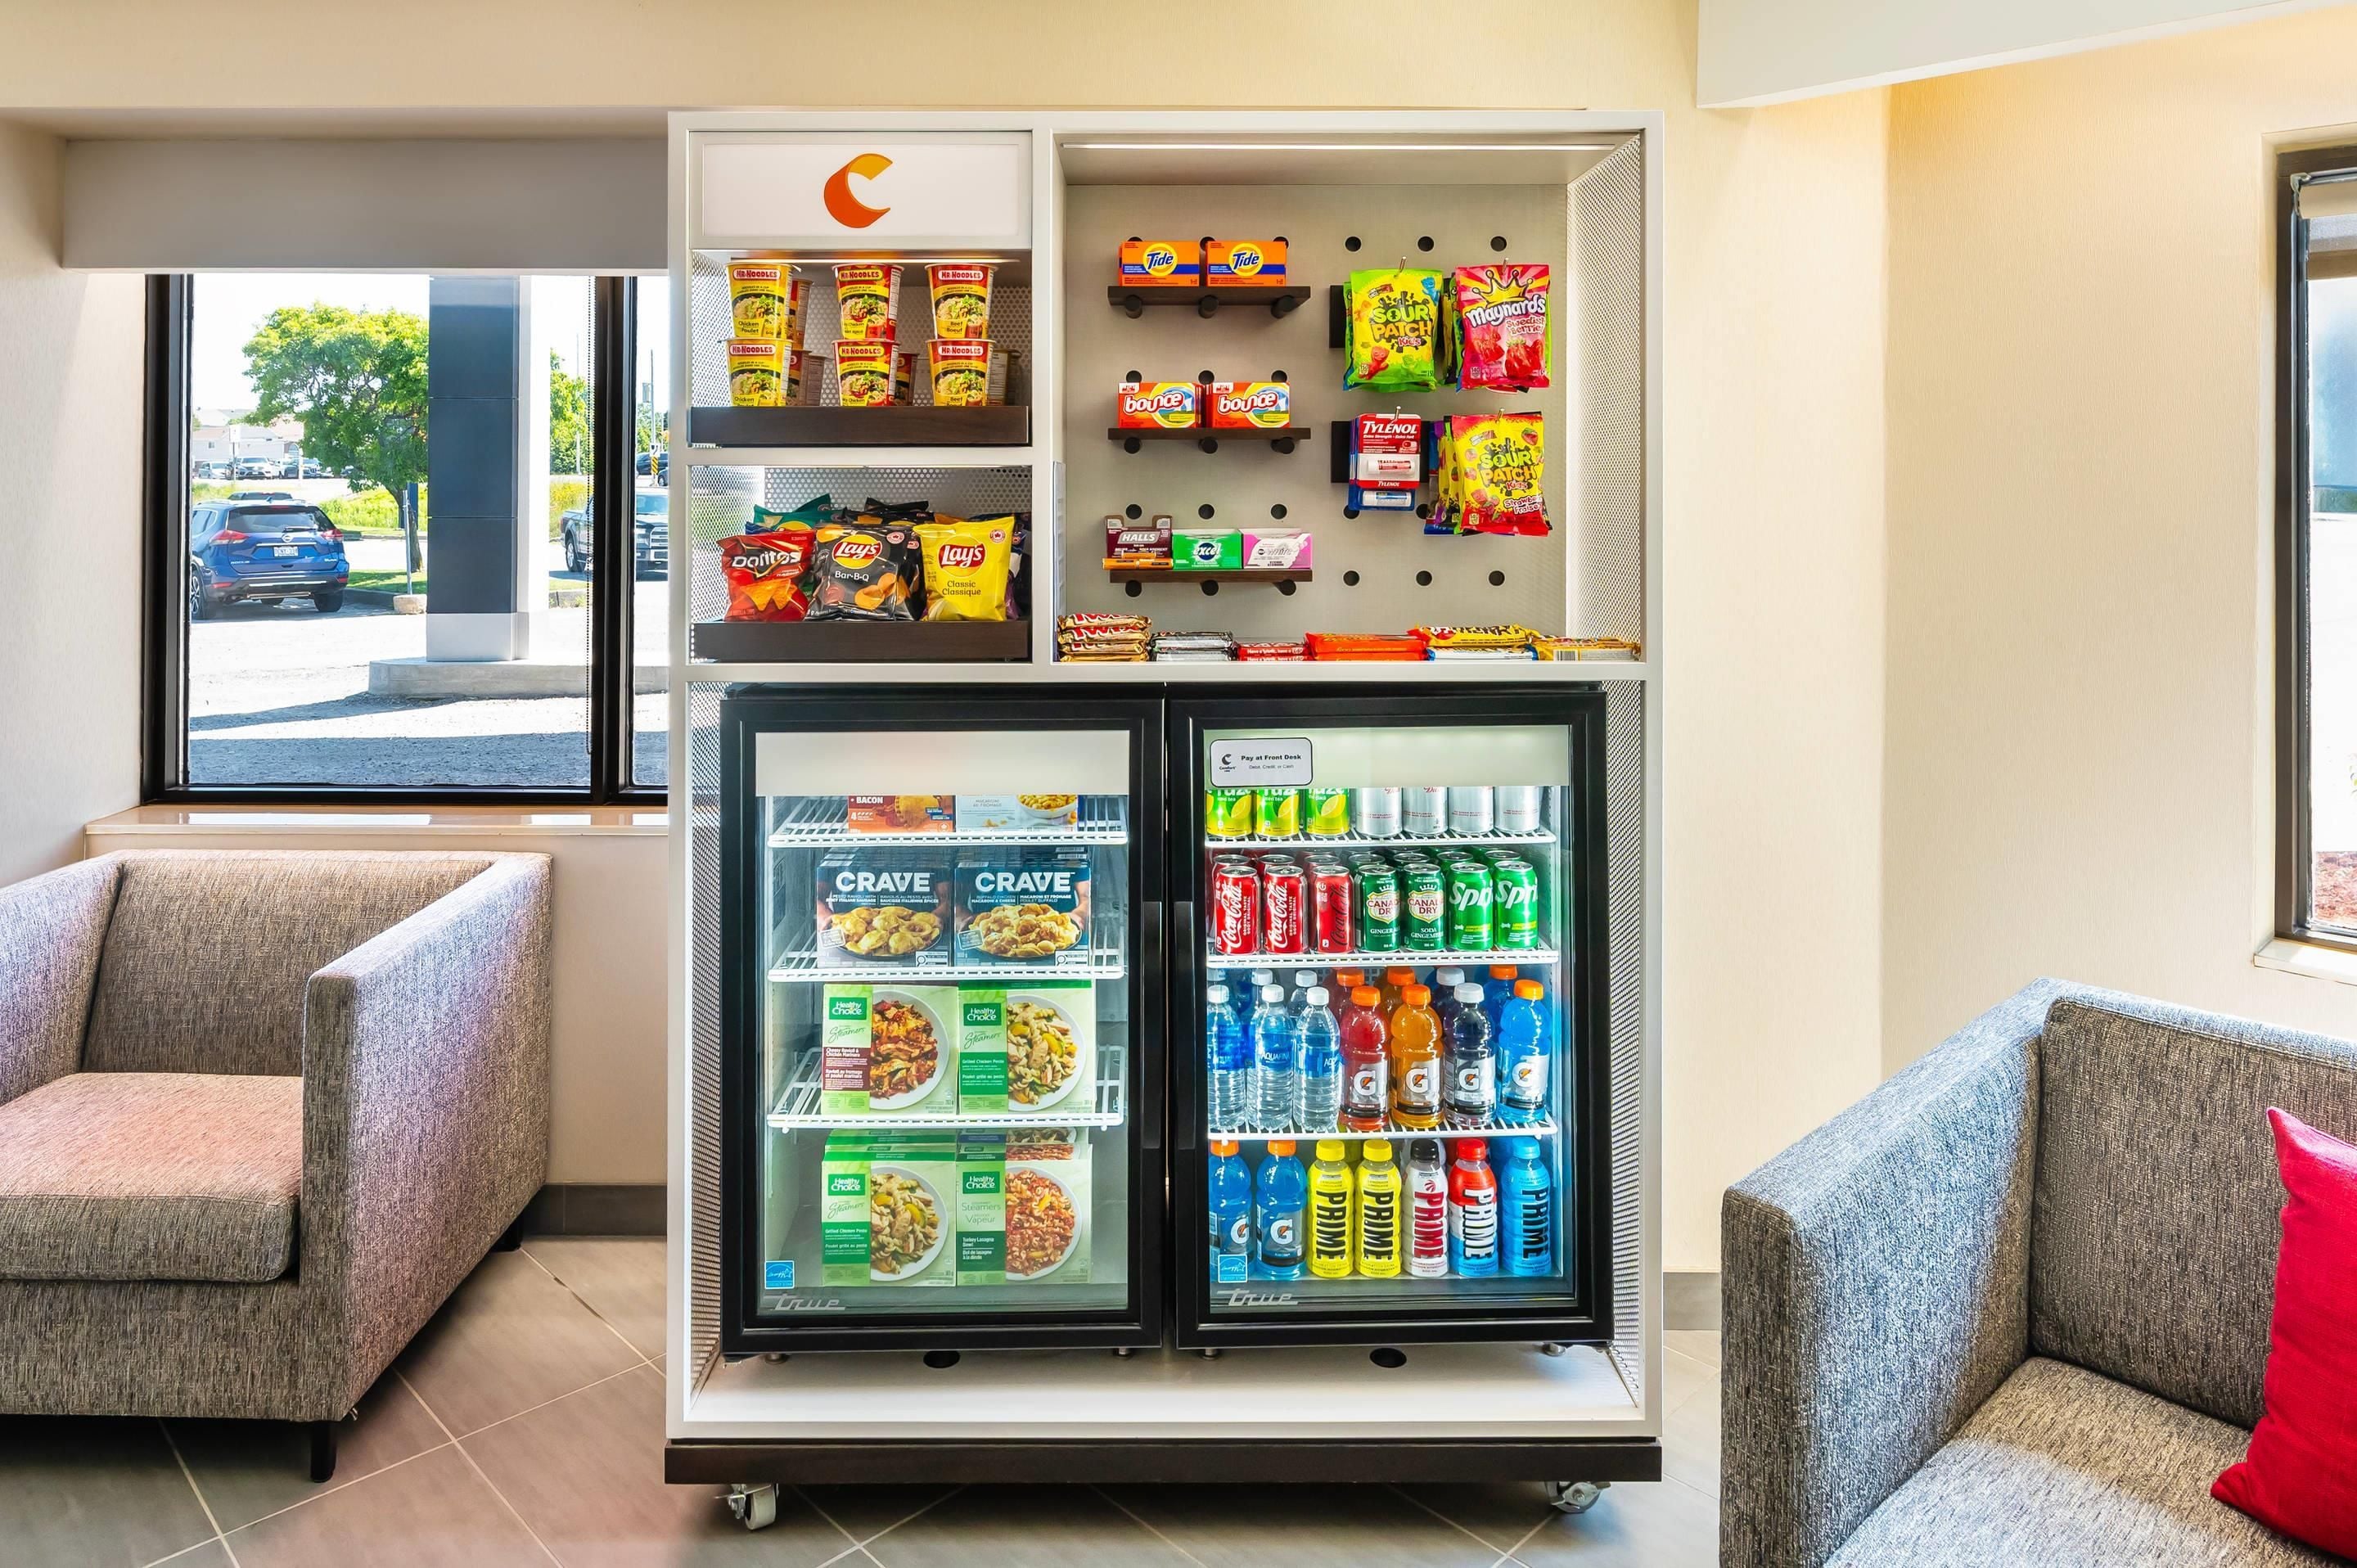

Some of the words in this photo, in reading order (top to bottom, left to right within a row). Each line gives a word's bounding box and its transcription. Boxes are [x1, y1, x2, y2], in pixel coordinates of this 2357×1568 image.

[1147, 252, 1174, 270] Tide
[1233, 252, 1260, 270] Tide
[746, 270, 777, 278] NOODLES
[849, 269, 880, 278] NOODLES
[1372, 304, 1430, 323] SOUR
[1467, 295, 1546, 328] Maynards
[1372, 320, 1432, 341] PATCH
[1398, 336, 1421, 347] Kids
[1125, 393, 1183, 413] bounce
[1219, 393, 1278, 413] bounce
[1363, 421, 1417, 435] TYLENOL
[1480, 451, 1532, 468] SOUR
[1480, 465, 1537, 487] PATCH
[1122, 534, 1156, 542] HALLS
[732, 551, 800, 568] Doritos
[835, 543, 879, 560] Lay's
[941, 545, 983, 568] Lay's
[1193, 543, 1221, 556] excel
[942, 588, 981, 597] Classique
[850, 812, 857, 820] 4
[836, 872, 931, 892] CRAVE
[976, 872, 1071, 892] CRAVE
[1221, 881, 1242, 948] Coca-Cola
[1267, 881, 1288, 948] Coca-Cola
[831, 1007, 863, 1016] Choice
[836, 1001, 862, 1009] Healthy
[1354, 1070, 1377, 1096] G
[1406, 1067, 1429, 1093] G
[1458, 1067, 1480, 1091] G
[1512, 1062, 1532, 1088] G
[831, 1183, 861, 1192] Choice
[962, 1202, 1001, 1211] Steamers
[965, 1214, 995, 1226] Vapeur
[1231, 1216, 1250, 1244] G
[1316, 1190, 1347, 1259] PRIME
[1363, 1189, 1395, 1260] PRIME
[1413, 1191, 1444, 1259] PRIME
[1462, 1187, 1494, 1259] PRIME
[1521, 1186, 1548, 1259] PRIME
[1270, 1219, 1293, 1245] G
